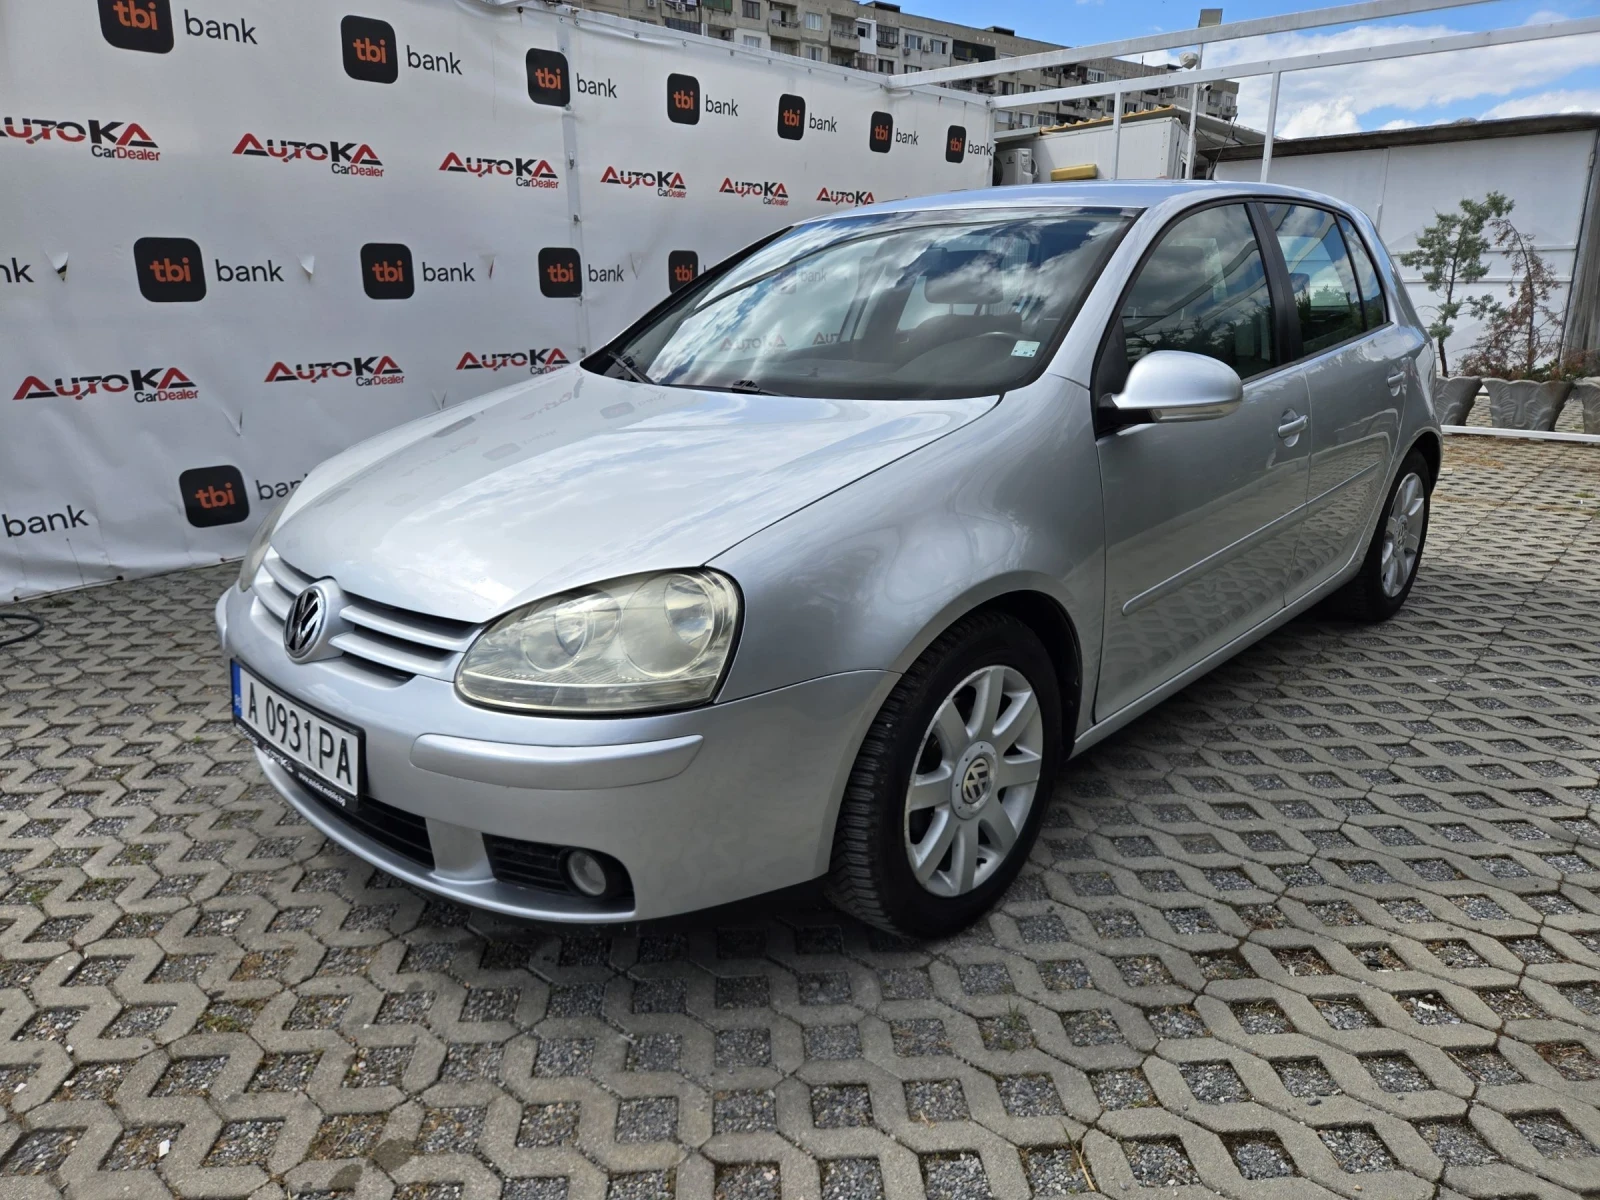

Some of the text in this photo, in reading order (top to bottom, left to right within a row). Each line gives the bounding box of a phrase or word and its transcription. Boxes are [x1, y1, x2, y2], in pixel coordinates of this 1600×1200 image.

[113, 0, 258, 45] tbi bank
[353, 37, 462, 75] tbi bank
[535, 67, 617, 98] tbi bank
[673, 90, 738, 117] tbi bank
[783, 109, 837, 133] tbi bank
[875, 125, 919, 145] tbi bank
[91, 145, 160, 161] CarDealer
[950, 138, 992, 156] tbi bank
[331, 163, 384, 177] CarDealer
[516, 177, 559, 189] CarDealer
[657, 188, 687, 198] CarDealer
[150, 257, 284, 282] tbi bank
[372, 260, 475, 282] tbi bank
[547, 264, 624, 282] tbi bank
[675, 264, 693, 281] tbi
[356, 374, 404, 386] CarDealer
[134, 389, 199, 403] CarDealer
[194, 482, 236, 509] tbi
[2, 505, 89, 538] bank
[248, 682, 258, 725] A
